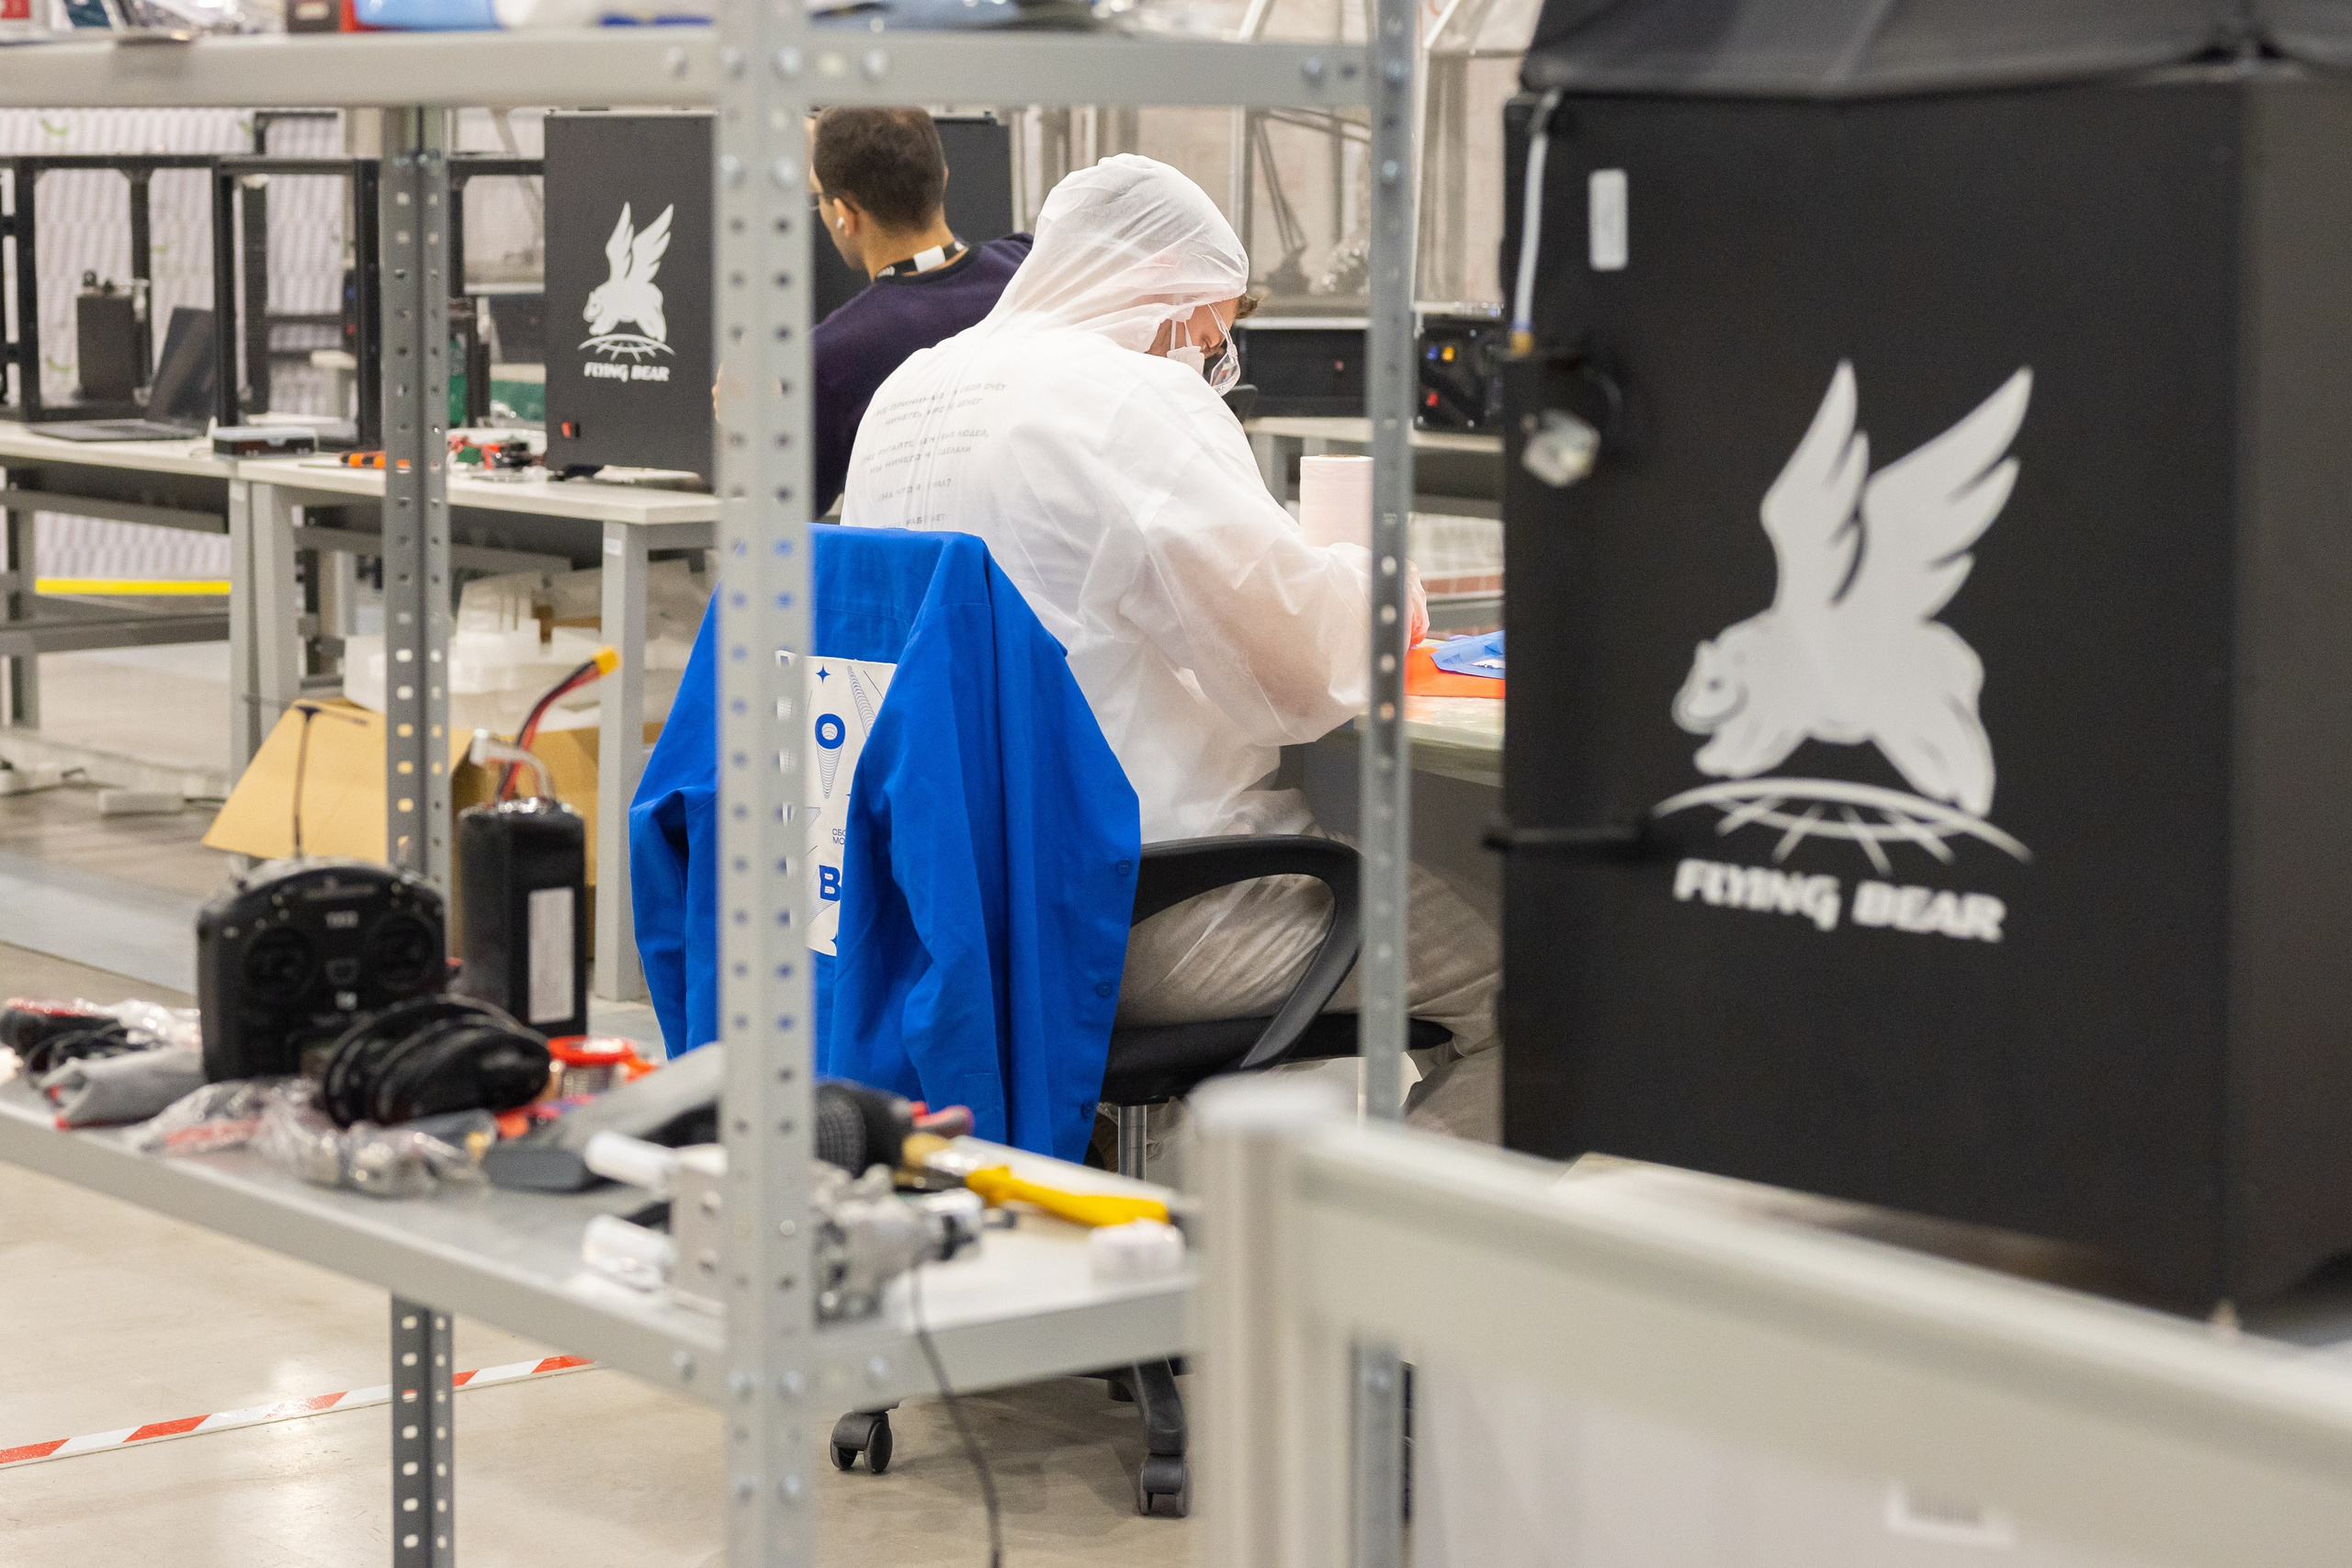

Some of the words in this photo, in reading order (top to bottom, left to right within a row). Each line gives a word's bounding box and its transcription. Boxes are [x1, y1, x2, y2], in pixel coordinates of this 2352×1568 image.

[631, 365, 670, 381] BEAR
[984, 382, 1007, 391] СЧЁТ
[877, 440, 915, 457] РУГАЙТЕ
[956, 429, 989, 439] ЛЮДЕЙ,
[885, 453, 922, 468] НИЧЕГО
[937, 446, 971, 457] СДЕЛАЛИ
[1850, 881, 2007, 943] BEAR
